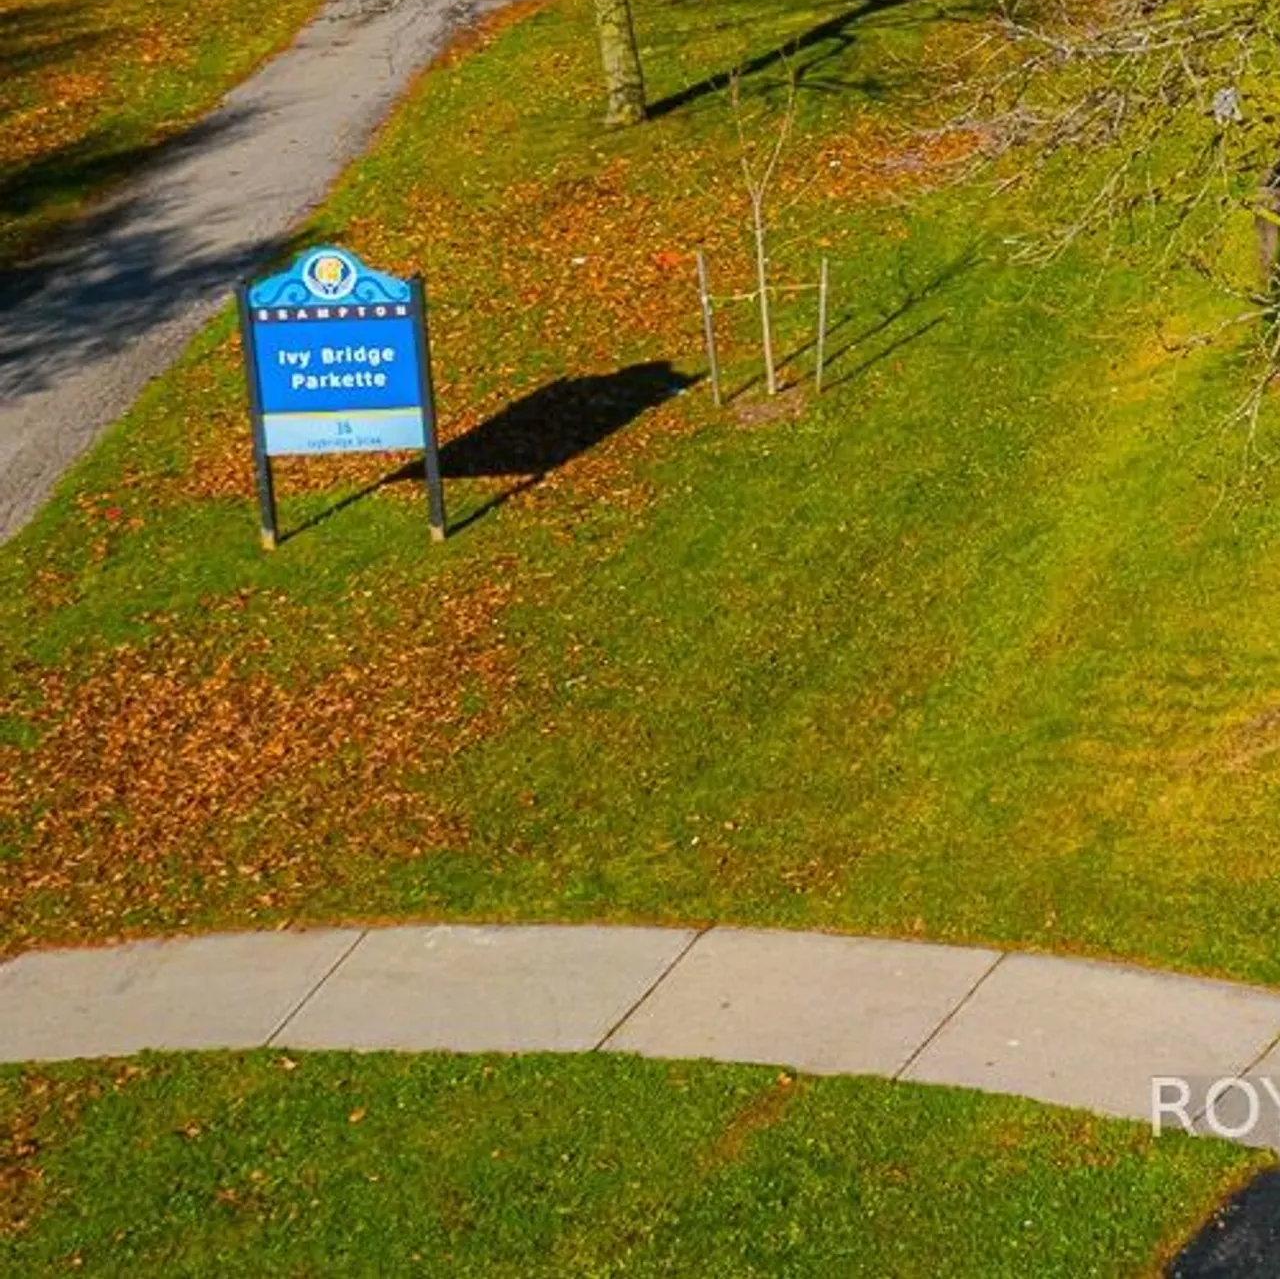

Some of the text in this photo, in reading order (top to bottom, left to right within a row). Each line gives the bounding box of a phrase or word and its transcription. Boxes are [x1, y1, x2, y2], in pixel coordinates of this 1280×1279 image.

[259, 306, 407, 321] BRAMPTON
[278, 347, 395, 368] Ivy Bridge
[292, 372, 387, 390] Parkette
